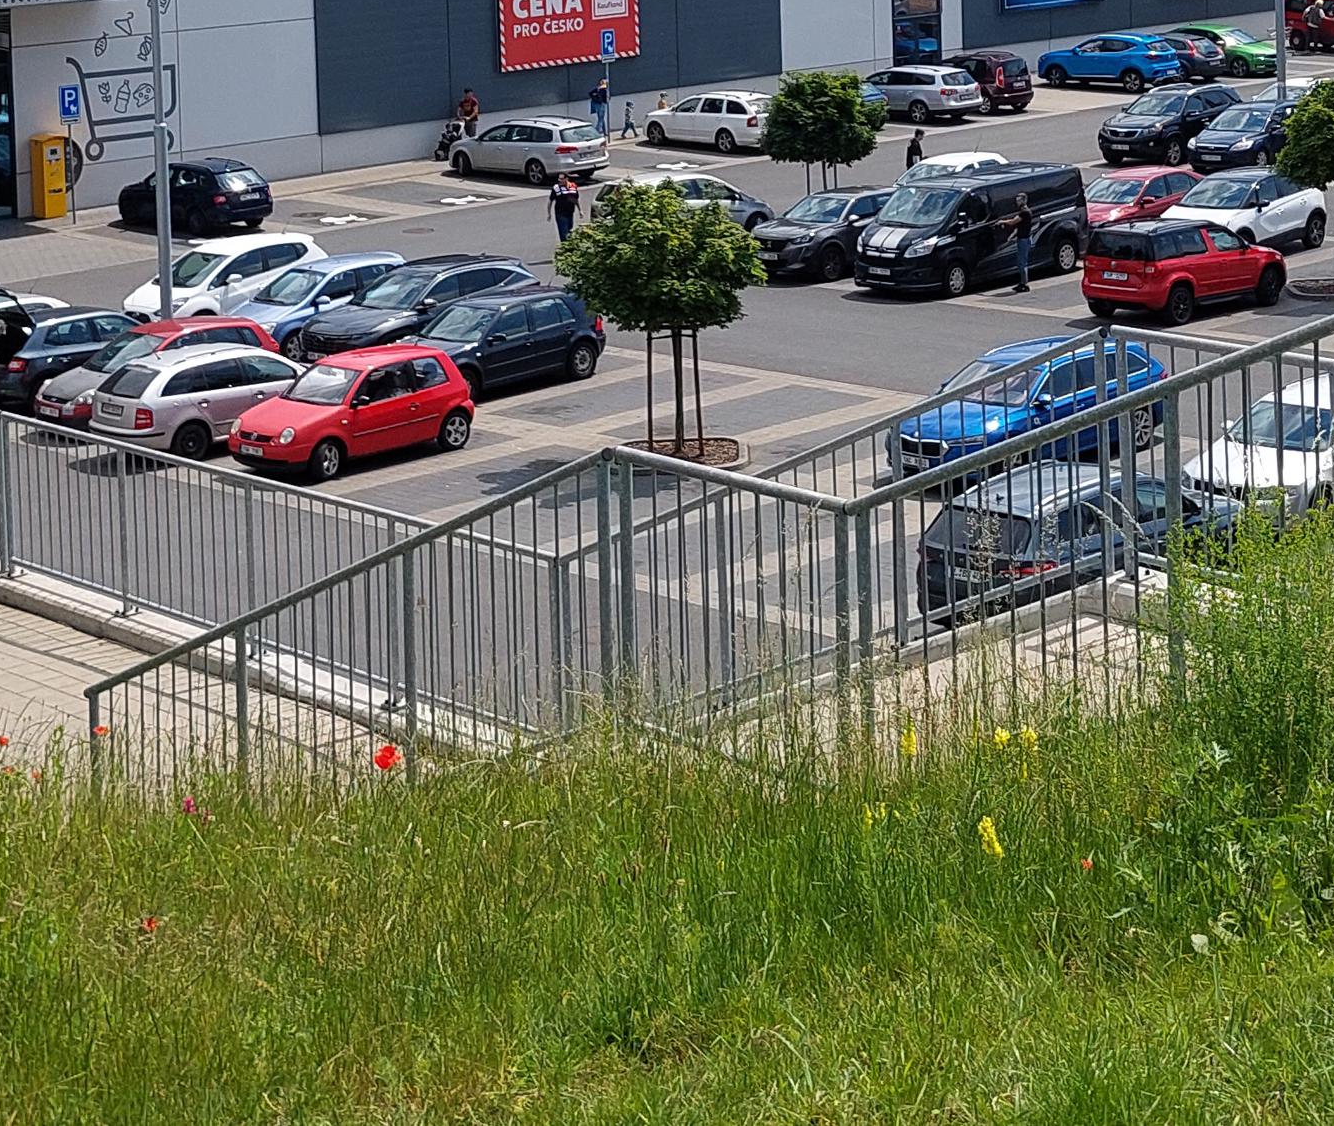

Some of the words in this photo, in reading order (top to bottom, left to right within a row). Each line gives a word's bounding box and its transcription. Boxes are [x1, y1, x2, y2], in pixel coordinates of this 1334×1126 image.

[597, 0, 623, 10] Kaufland
[513, 22, 540, 38] PRO
[543, 17, 584, 35] ČESKO
[605, 33, 613, 47] P
[64, 89, 76, 108] P
